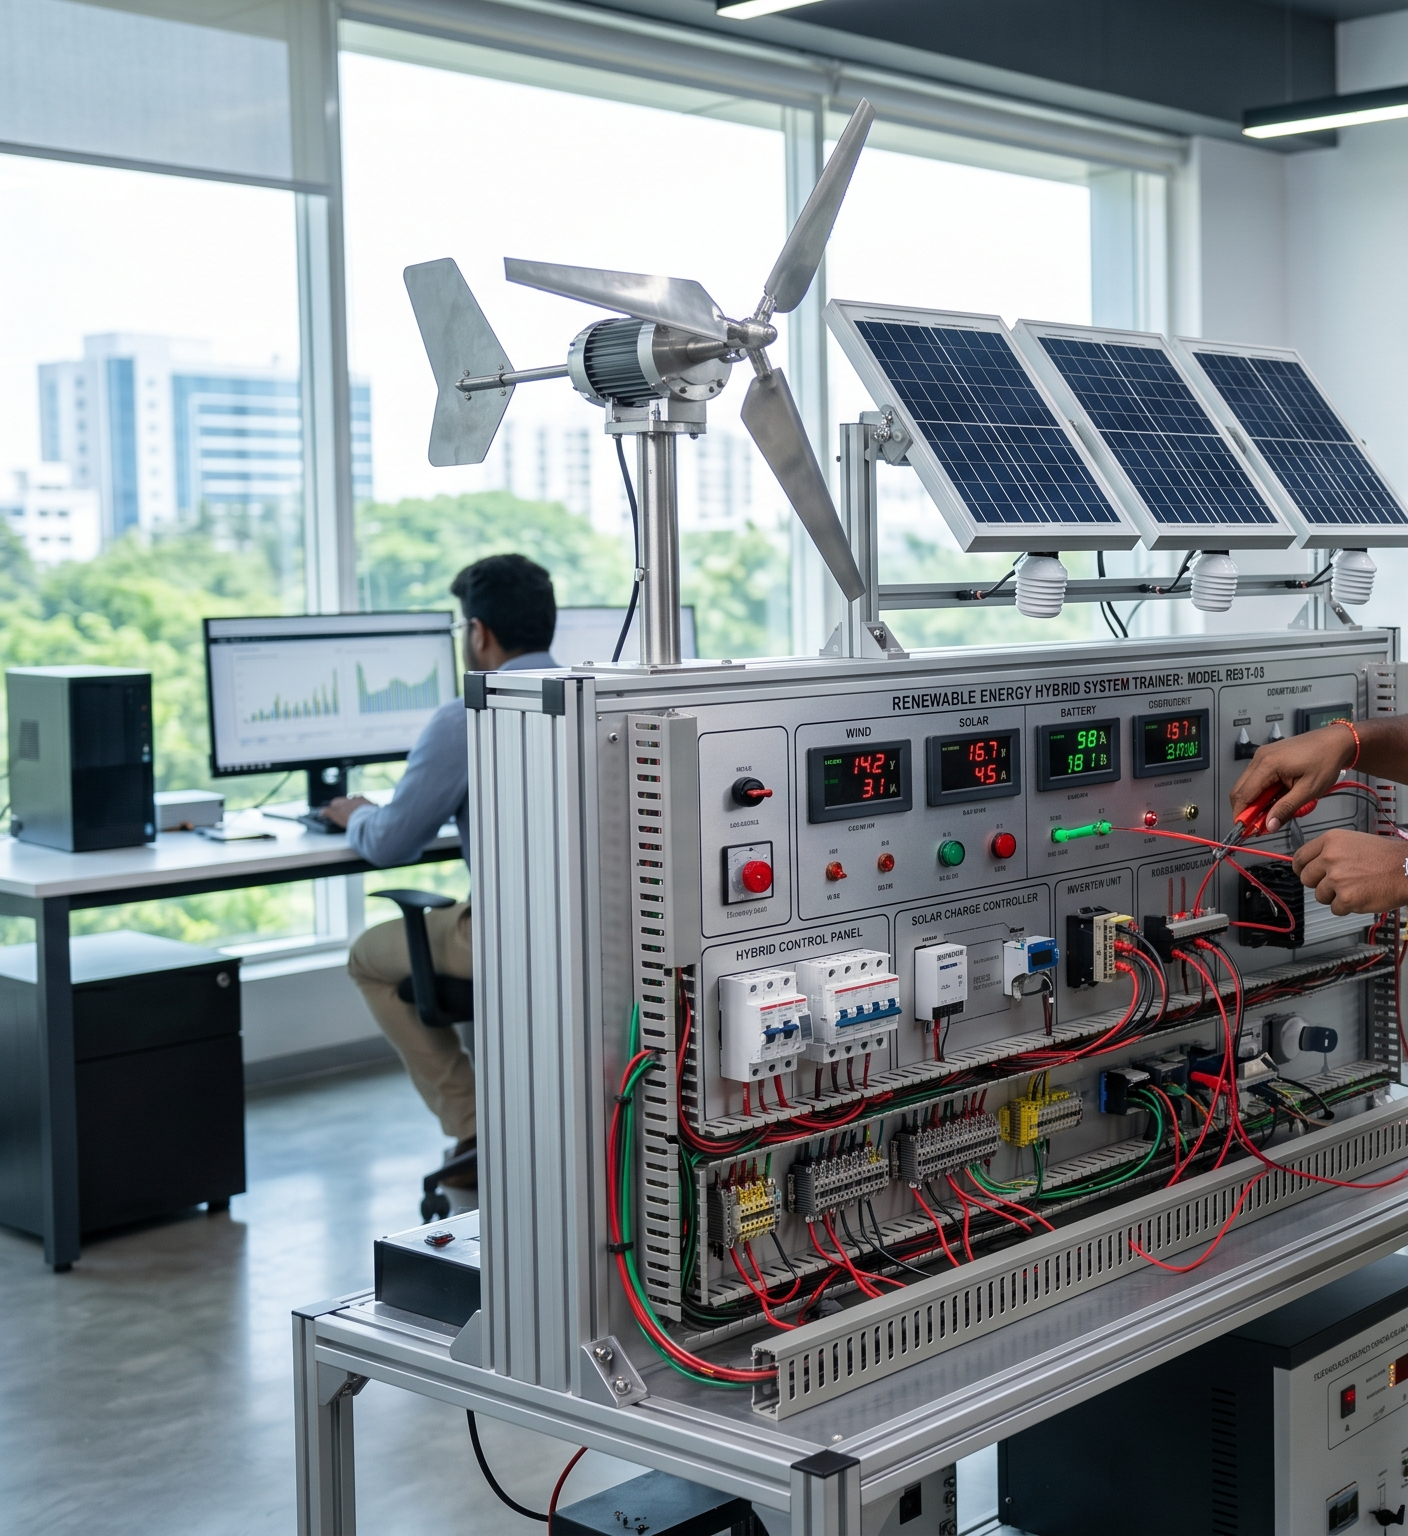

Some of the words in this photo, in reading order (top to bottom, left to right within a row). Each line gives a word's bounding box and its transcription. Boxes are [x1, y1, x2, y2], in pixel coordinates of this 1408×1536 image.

[892, 690, 976, 711] RENEWABLE
[980, 685, 1032, 704] ENERGY
[1035, 681, 1080, 699] HYBRID
[1084, 677, 1130, 694] SYSTEM
[1132, 673, 1183, 690] TRAINER:
[1187, 670, 1223, 685] MODEL
[1060, 705, 1097, 717] BATTERY
[959, 716, 989, 727] SOLAR
[846, 726, 872, 738] WIND
[1105, 875, 1121, 887] UNIT
[911, 911, 943, 926] SOLAR
[944, 903, 981, 920] CHARGE
[983, 892, 1038, 912] CONTROLLER
[736, 943, 776, 961] HYBRID
[779, 934, 828, 953] CONTROL
[830, 927, 863, 942] PANEL
